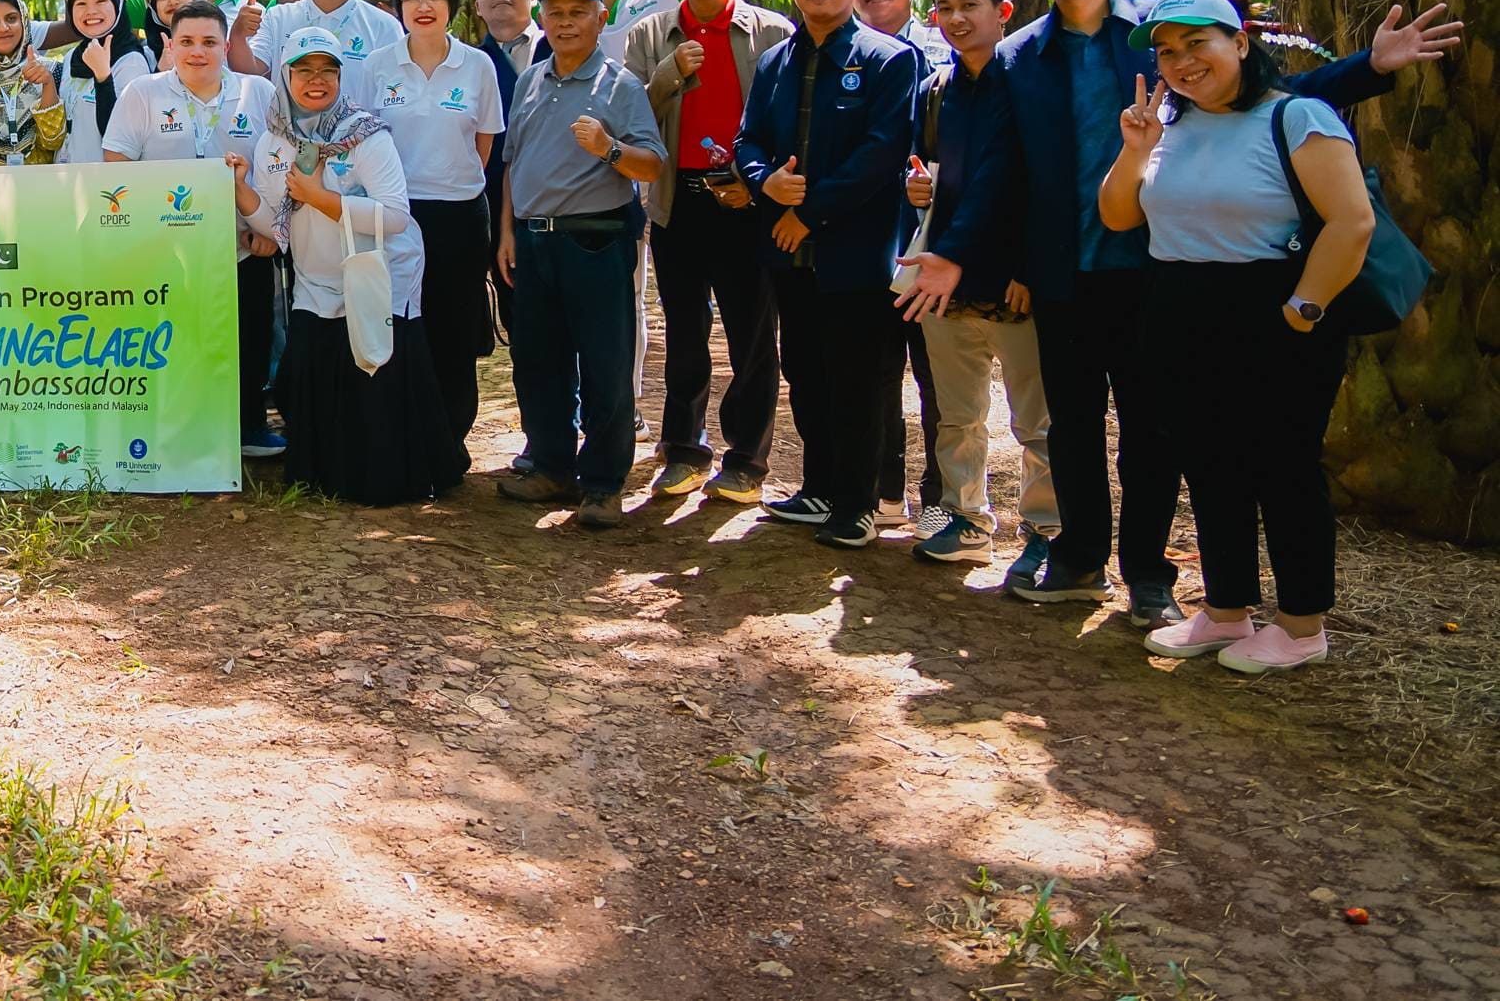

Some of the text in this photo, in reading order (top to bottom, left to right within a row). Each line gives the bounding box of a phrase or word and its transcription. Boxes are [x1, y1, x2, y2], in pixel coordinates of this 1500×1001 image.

[383, 96, 405, 106] CPOPC
[160, 122, 184, 131] CPOPC
[267, 161, 289, 172] CPOPC
[100, 214, 131, 225] CPOPC
[21, 286, 134, 311] Program
[143, 284, 169, 306] of
[0, 402, 19, 413] May
[21, 402, 46, 412] 2024,
[47, 401, 91, 411] Indonesia
[92, 401, 110, 410] and
[112, 401, 149, 412] Malaysia
[115, 461, 128, 469] IPB
[129, 461, 162, 472] University
